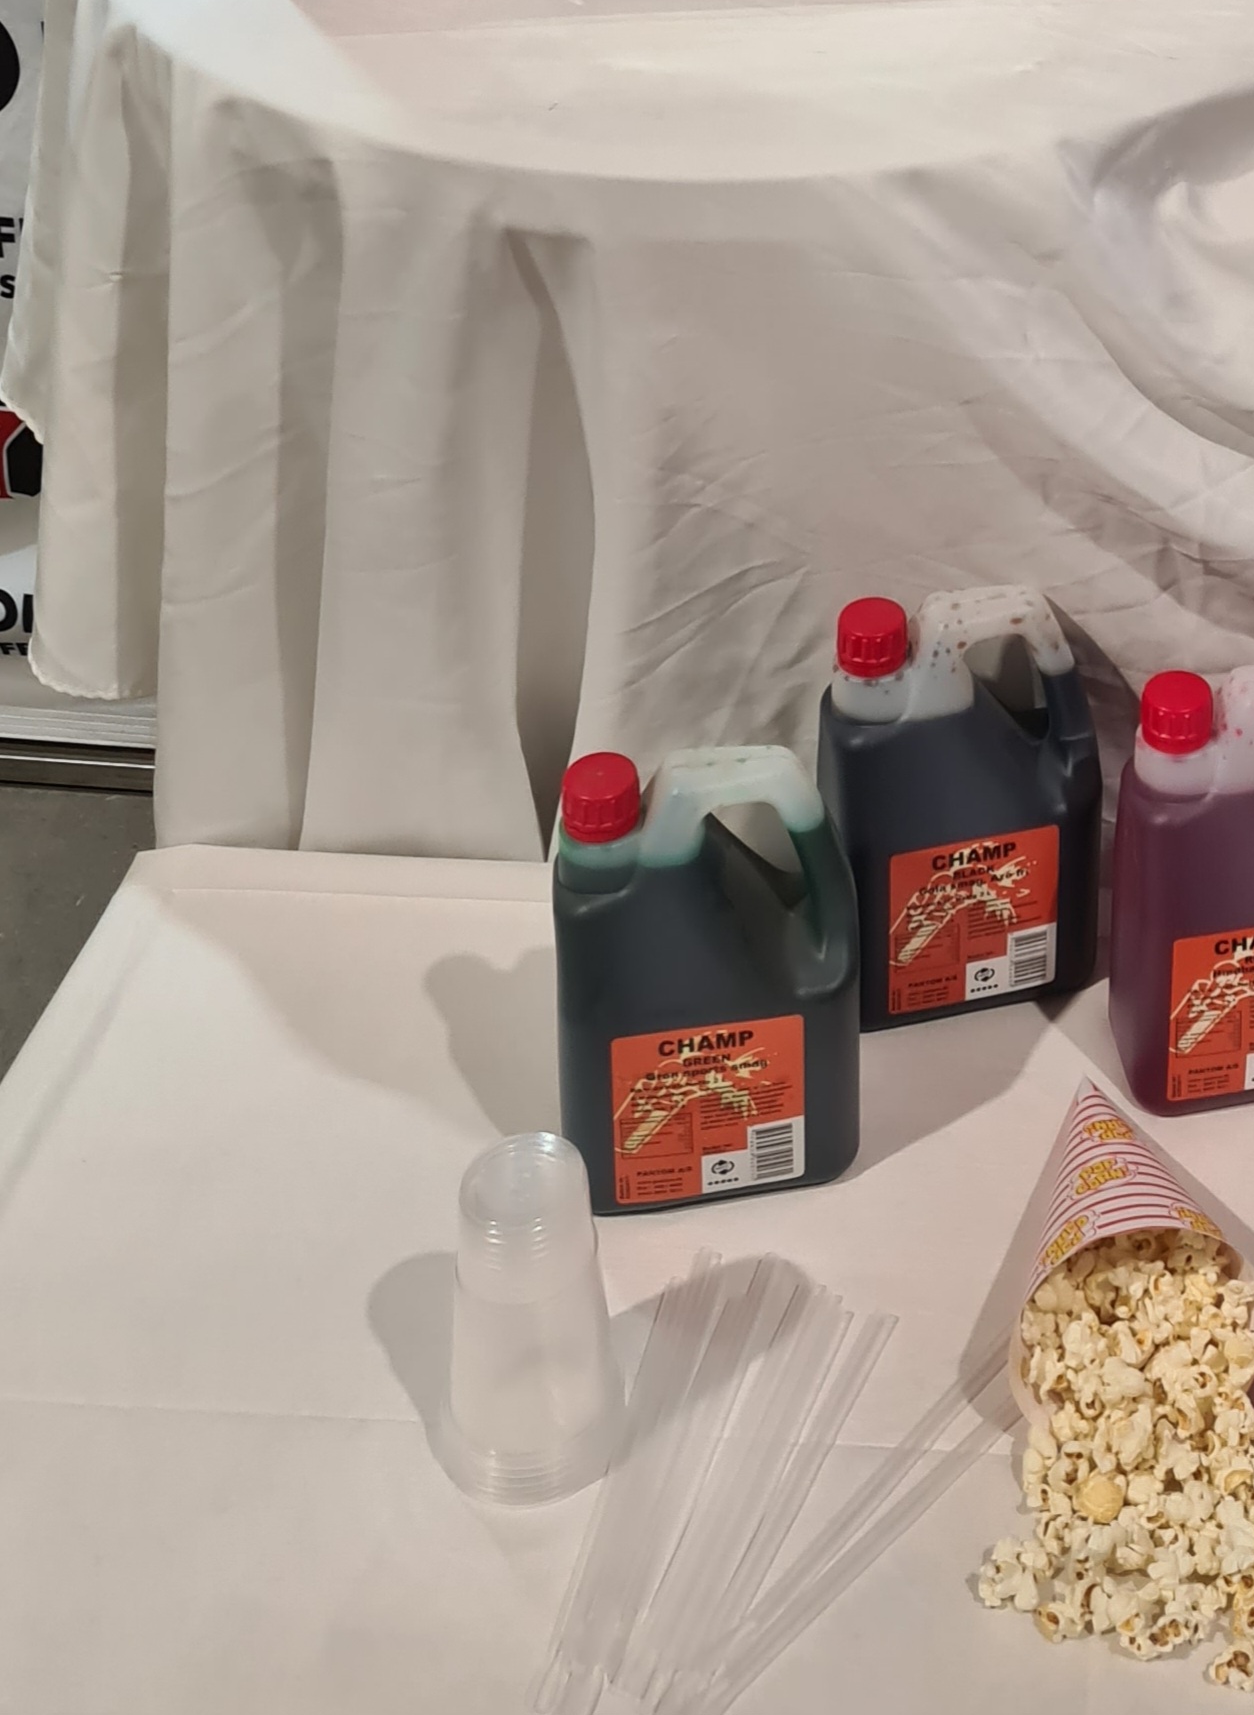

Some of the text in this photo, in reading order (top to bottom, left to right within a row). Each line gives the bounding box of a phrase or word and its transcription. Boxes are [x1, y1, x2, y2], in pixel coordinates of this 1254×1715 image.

[930, 842, 1017, 871] CHAMP
[658, 1030, 754, 1057] CHAMP
[683, 1053, 731, 1068] GREEN
